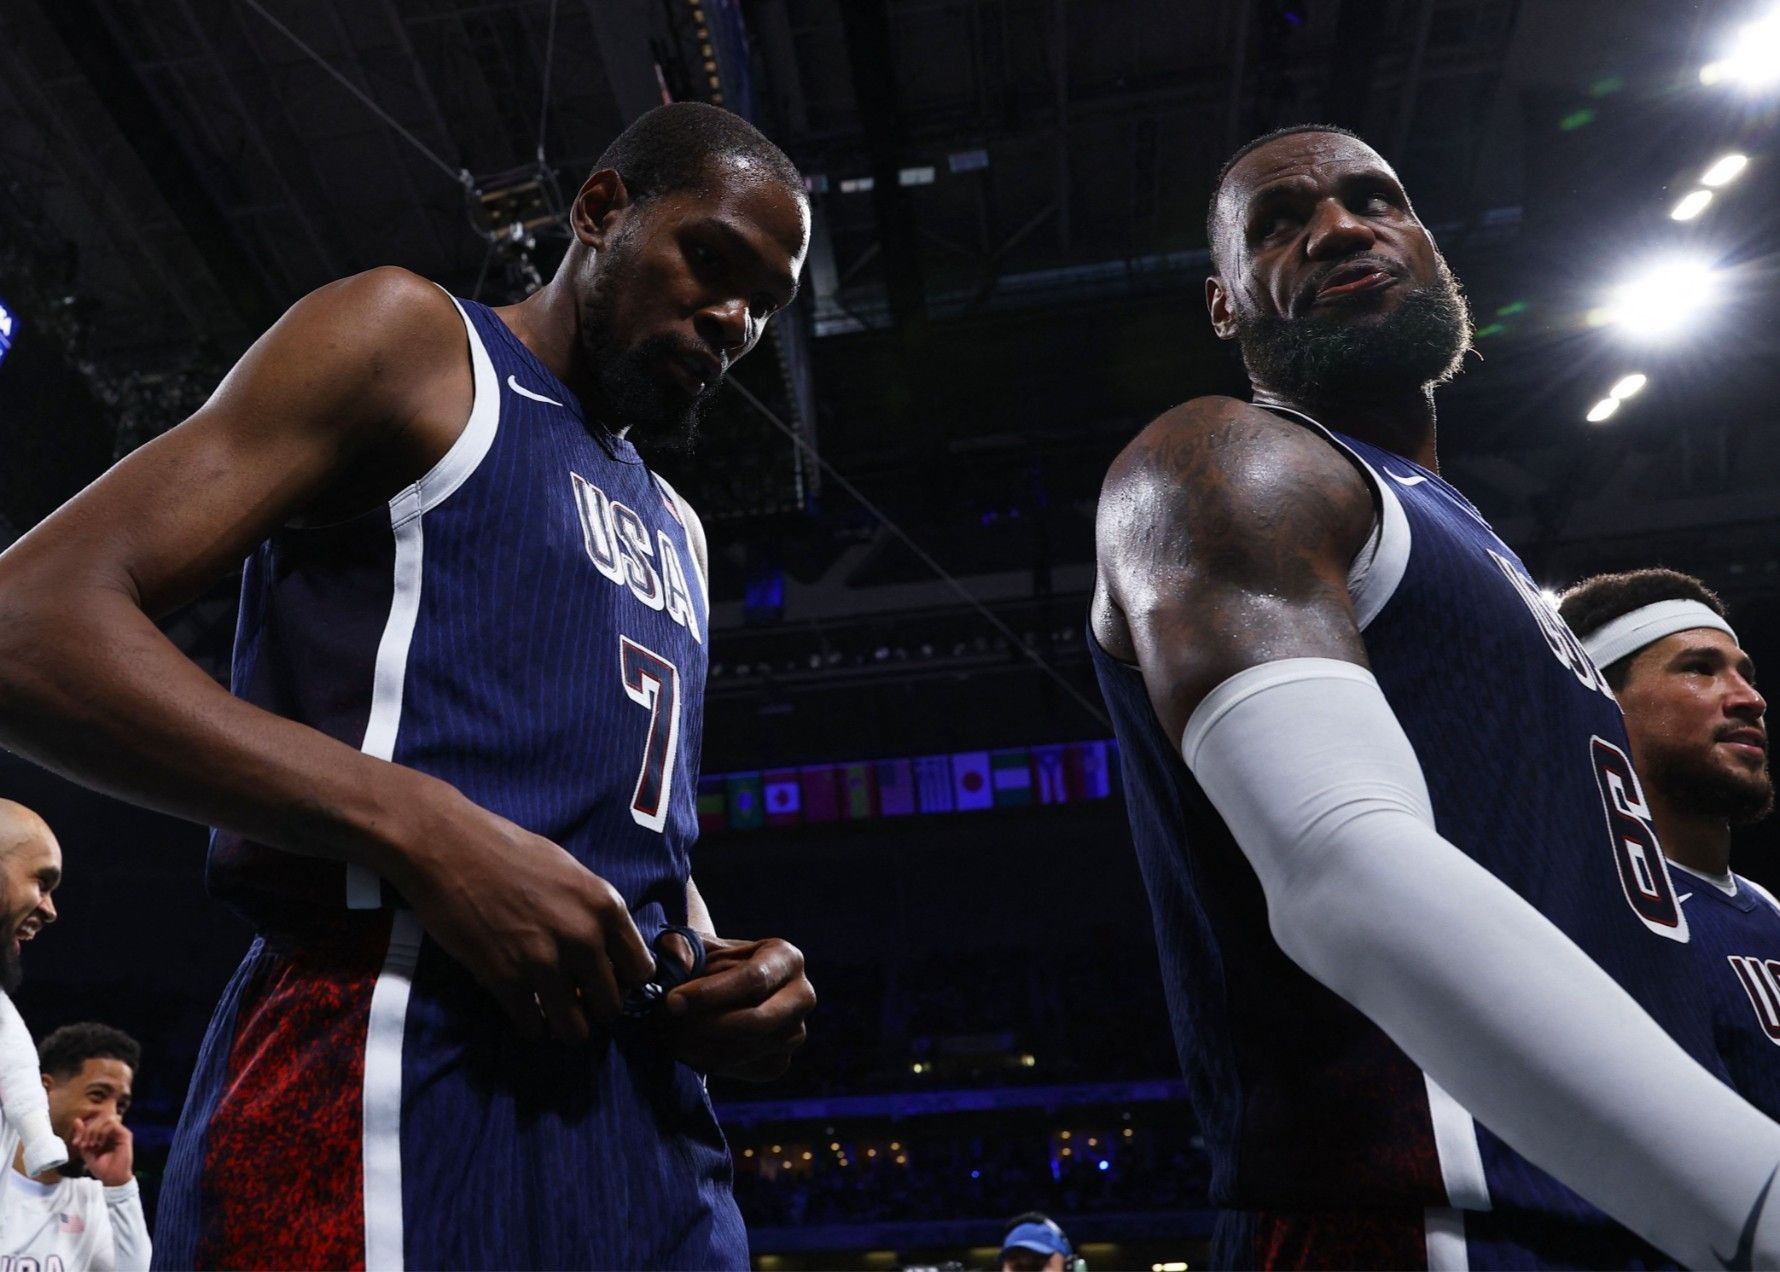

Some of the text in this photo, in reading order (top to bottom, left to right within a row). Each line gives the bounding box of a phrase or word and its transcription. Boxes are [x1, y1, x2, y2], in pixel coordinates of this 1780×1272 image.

[570, 471, 702, 644] USA
[620, 634, 681, 834] 7
[1590, 734, 1691, 945] 6
